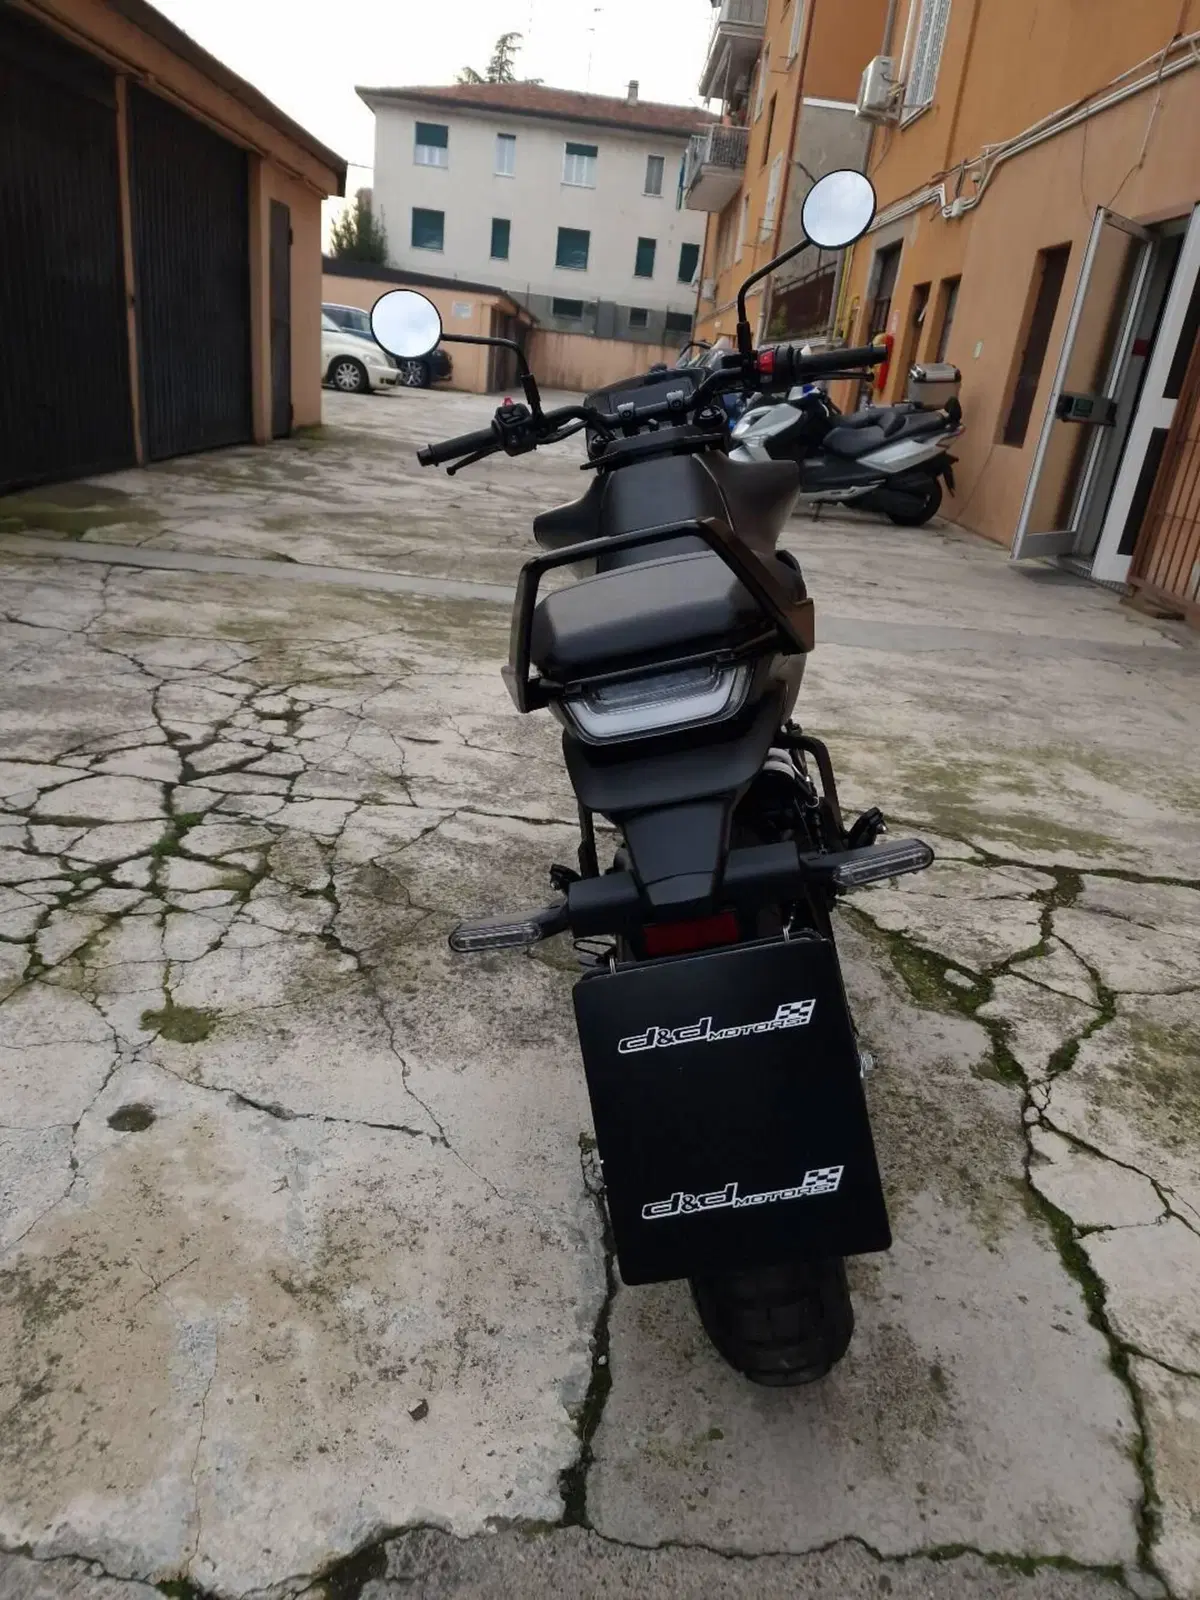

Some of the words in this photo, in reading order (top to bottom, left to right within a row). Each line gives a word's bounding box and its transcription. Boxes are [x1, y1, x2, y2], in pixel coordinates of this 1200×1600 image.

[618, 1016, 712, 1053] d&d
[707, 1017, 806, 1041] MOTORS
[642, 1182, 738, 1219] d&d
[733, 1183, 831, 1207] MOTORS
